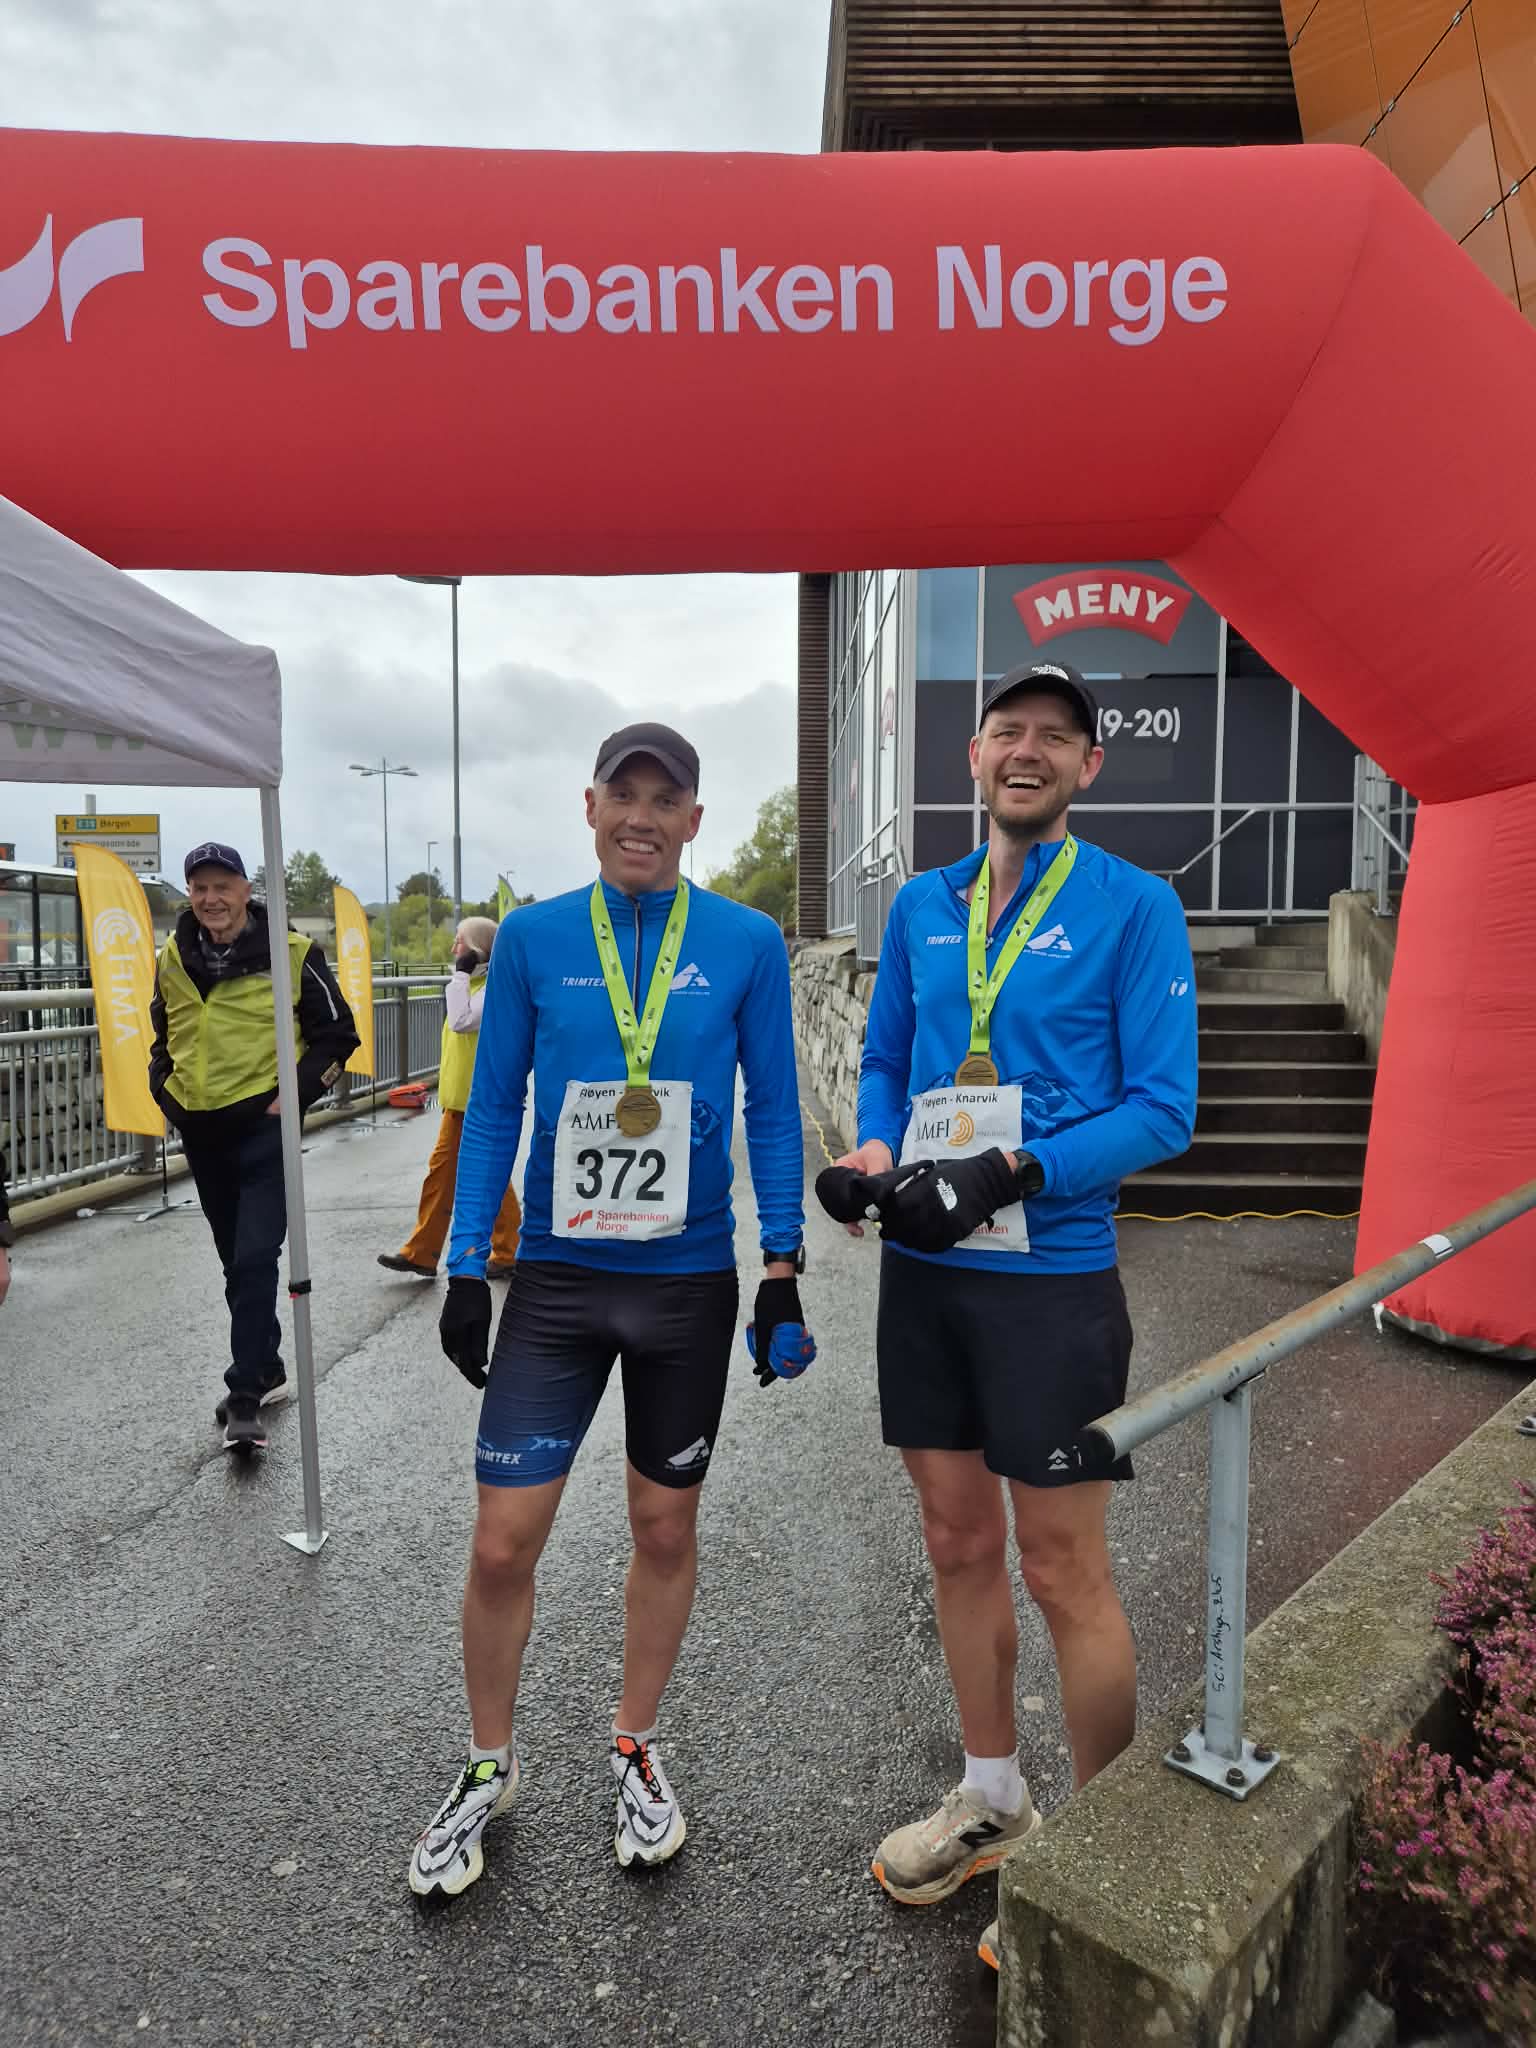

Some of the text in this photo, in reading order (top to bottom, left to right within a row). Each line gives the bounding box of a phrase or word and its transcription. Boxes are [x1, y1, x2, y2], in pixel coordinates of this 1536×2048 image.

[202, 237, 1228, 349] Sparebanken Norge
[1034, 583, 1175, 627] MENY
[1096, 707, 1181, 743] (9-20)
[955, 1092, 999, 1104] Knarvik
[575, 1148, 666, 1202] 372
[596, 1221, 629, 1233] Norge
[597, 1209, 670, 1224] Sparebanken
